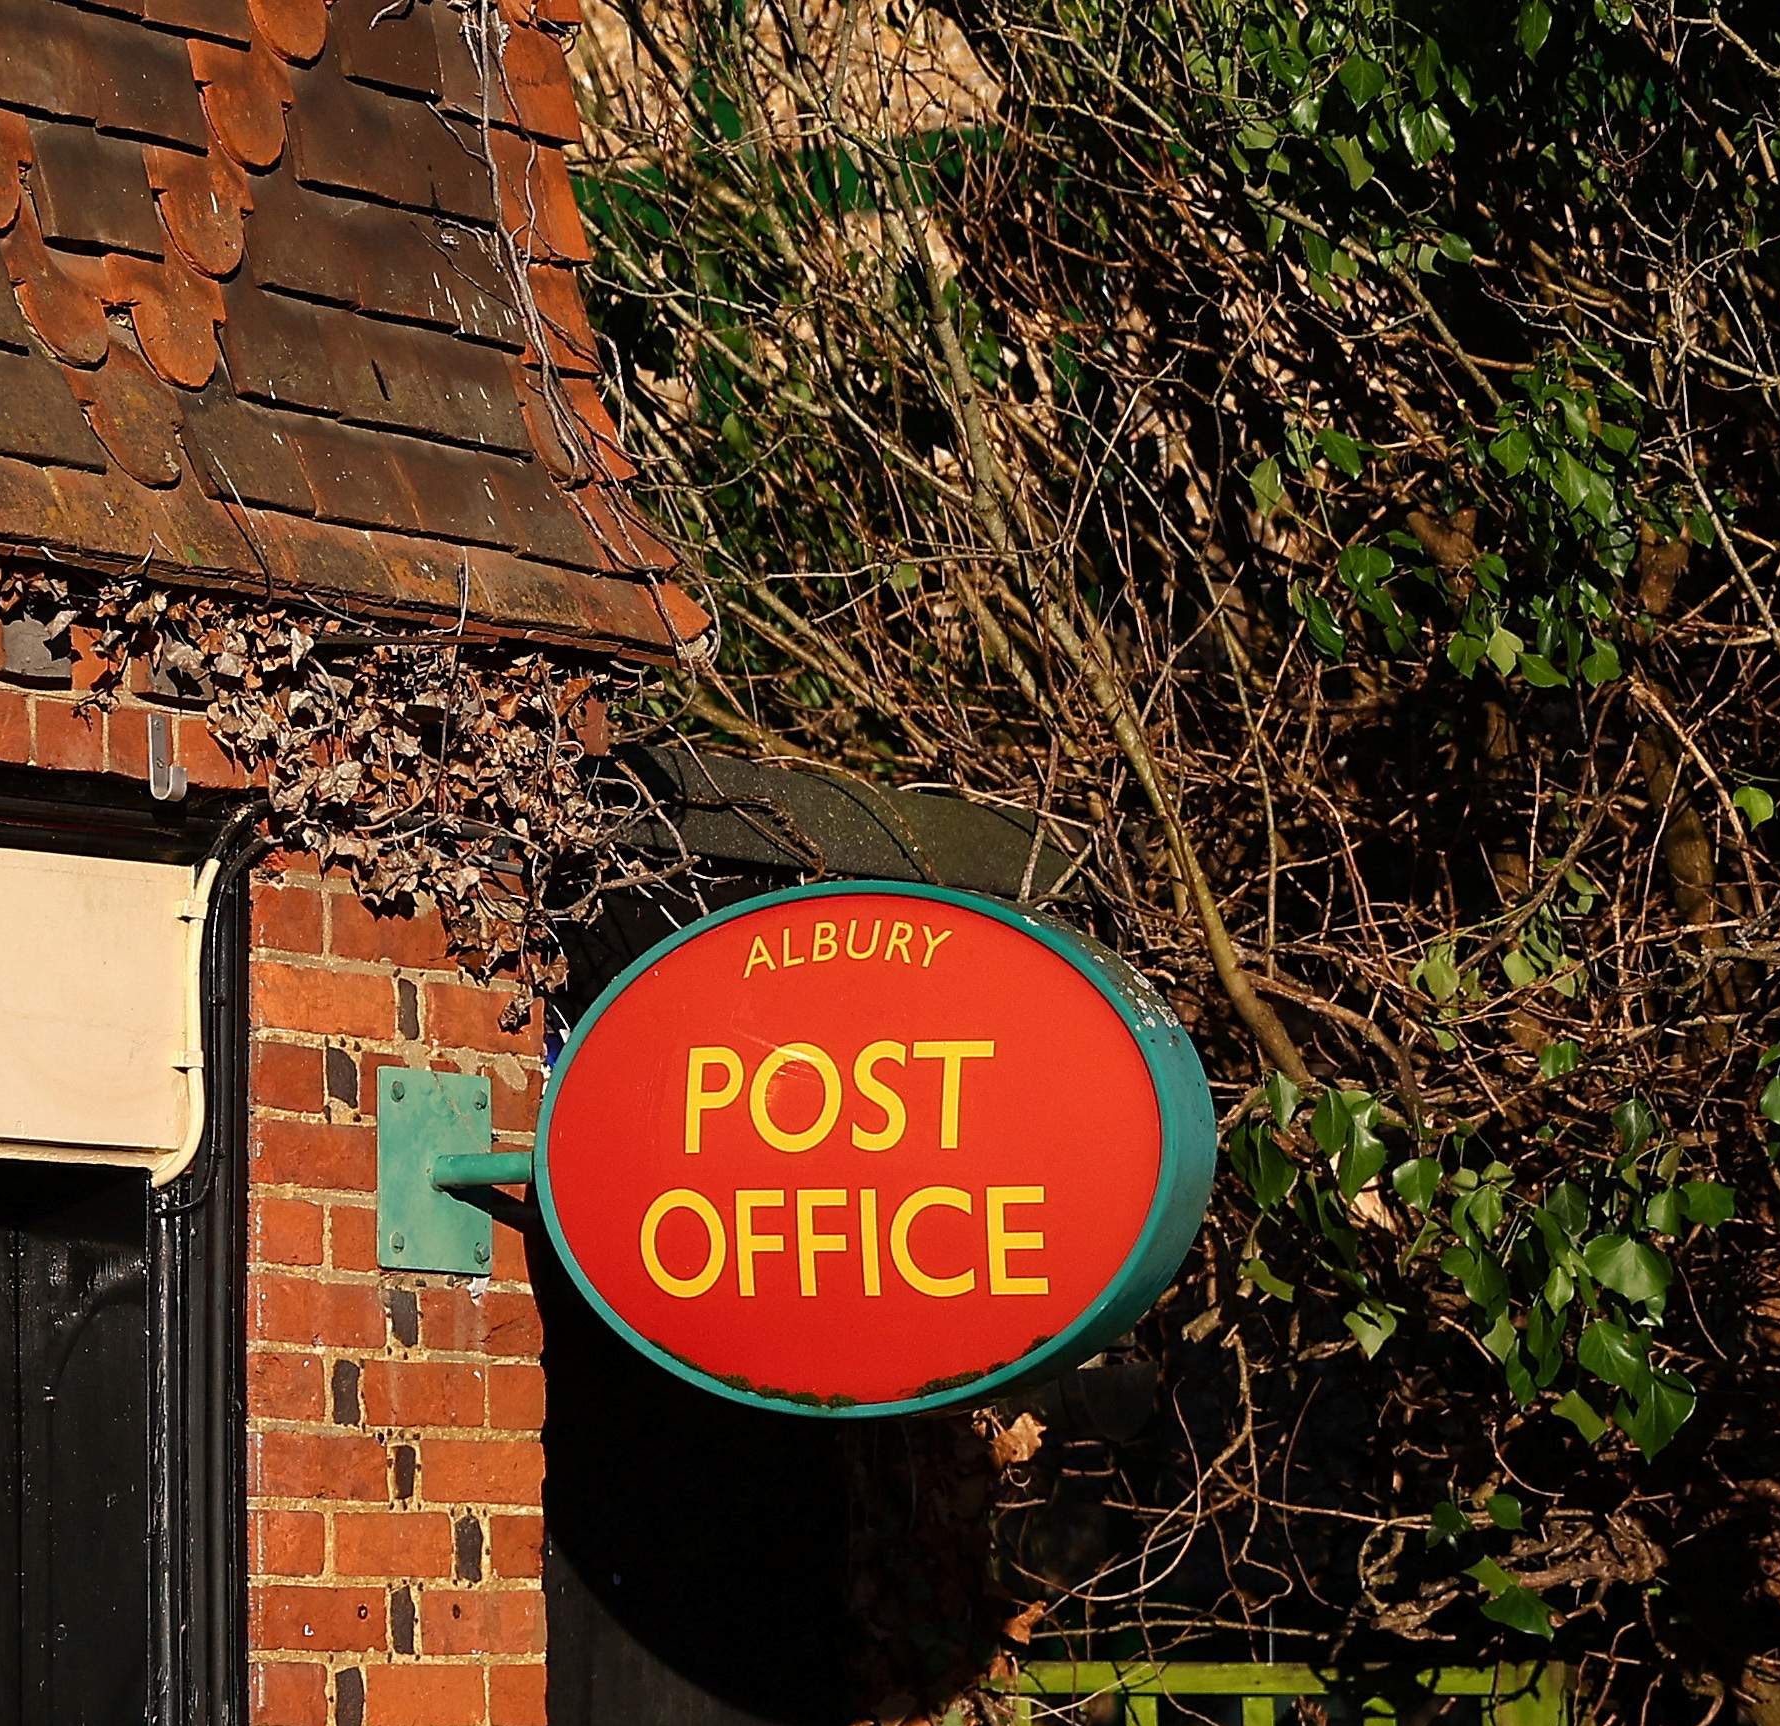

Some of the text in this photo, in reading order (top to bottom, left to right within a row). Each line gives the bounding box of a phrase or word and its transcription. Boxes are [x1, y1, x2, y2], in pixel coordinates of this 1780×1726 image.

[743, 920, 952, 979] ALBURY
[685, 1040, 995, 1155] POST
[640, 1186, 1049, 1298] OFFICE
